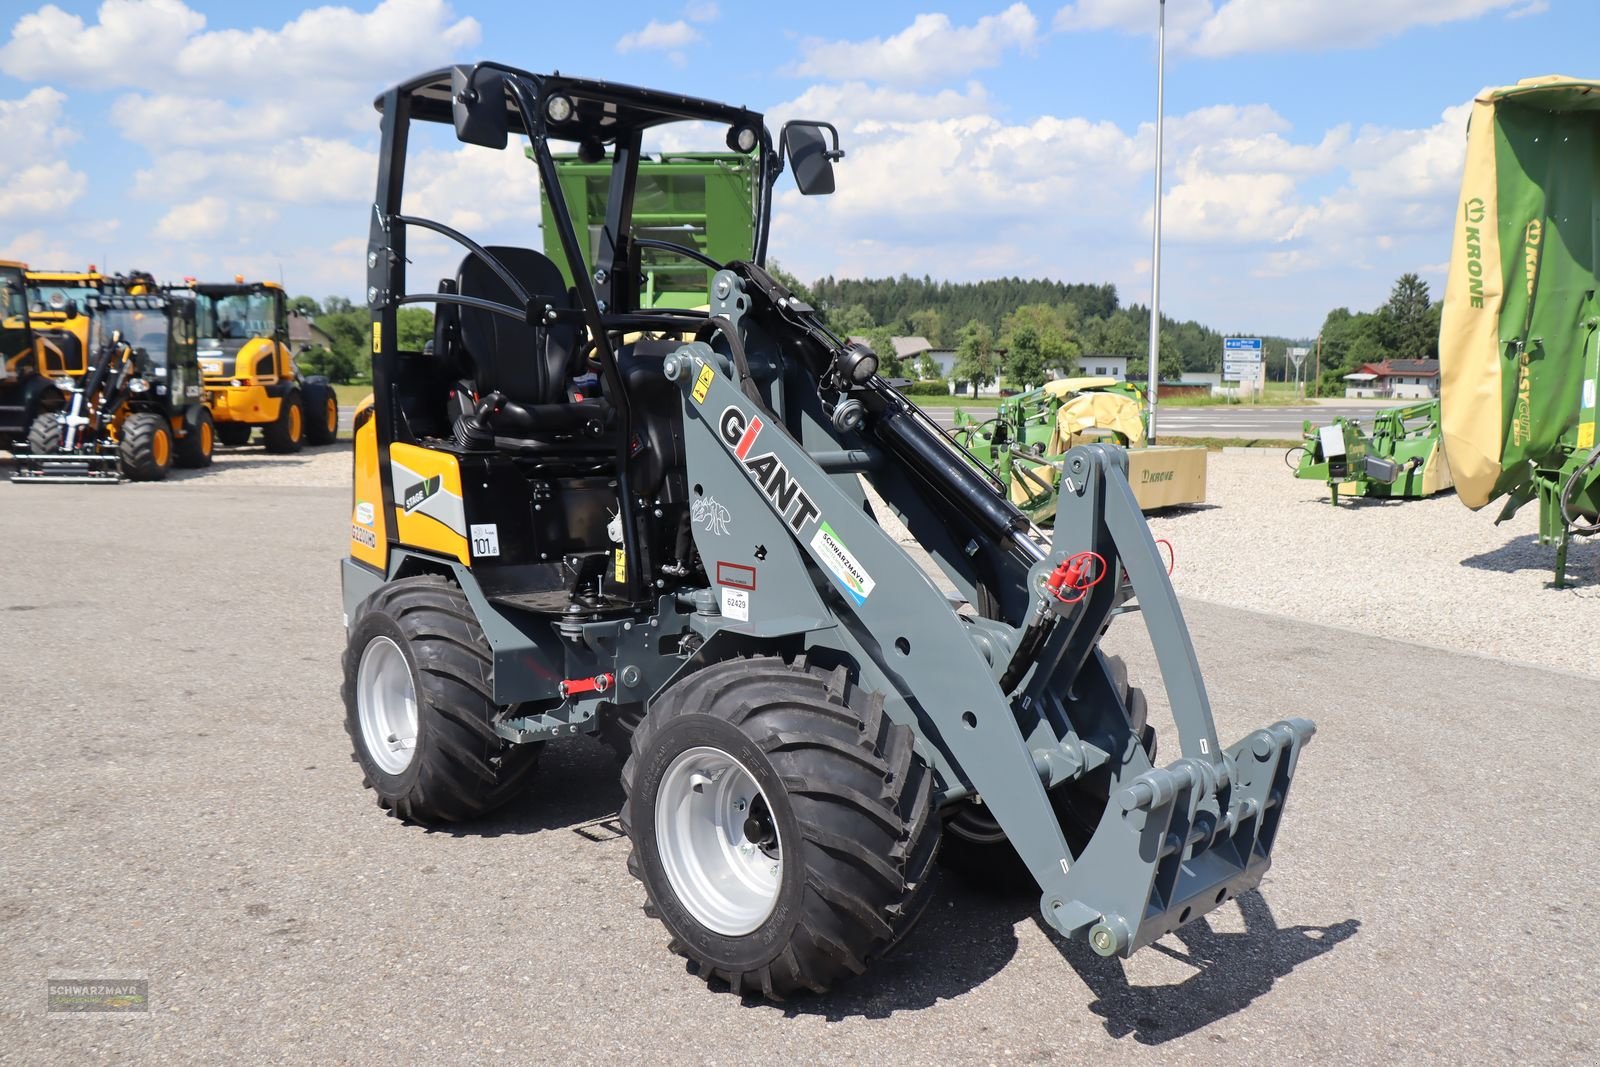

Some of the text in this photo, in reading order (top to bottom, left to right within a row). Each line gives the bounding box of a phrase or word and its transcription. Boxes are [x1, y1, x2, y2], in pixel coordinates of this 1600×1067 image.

[1465, 226, 1484, 309] KRONE
[405, 490, 424, 509] STAGE
[474, 538, 491, 554] 101
[823, 533, 865, 584] SCHWARZMAYR
[727, 598, 746, 609] 62429
